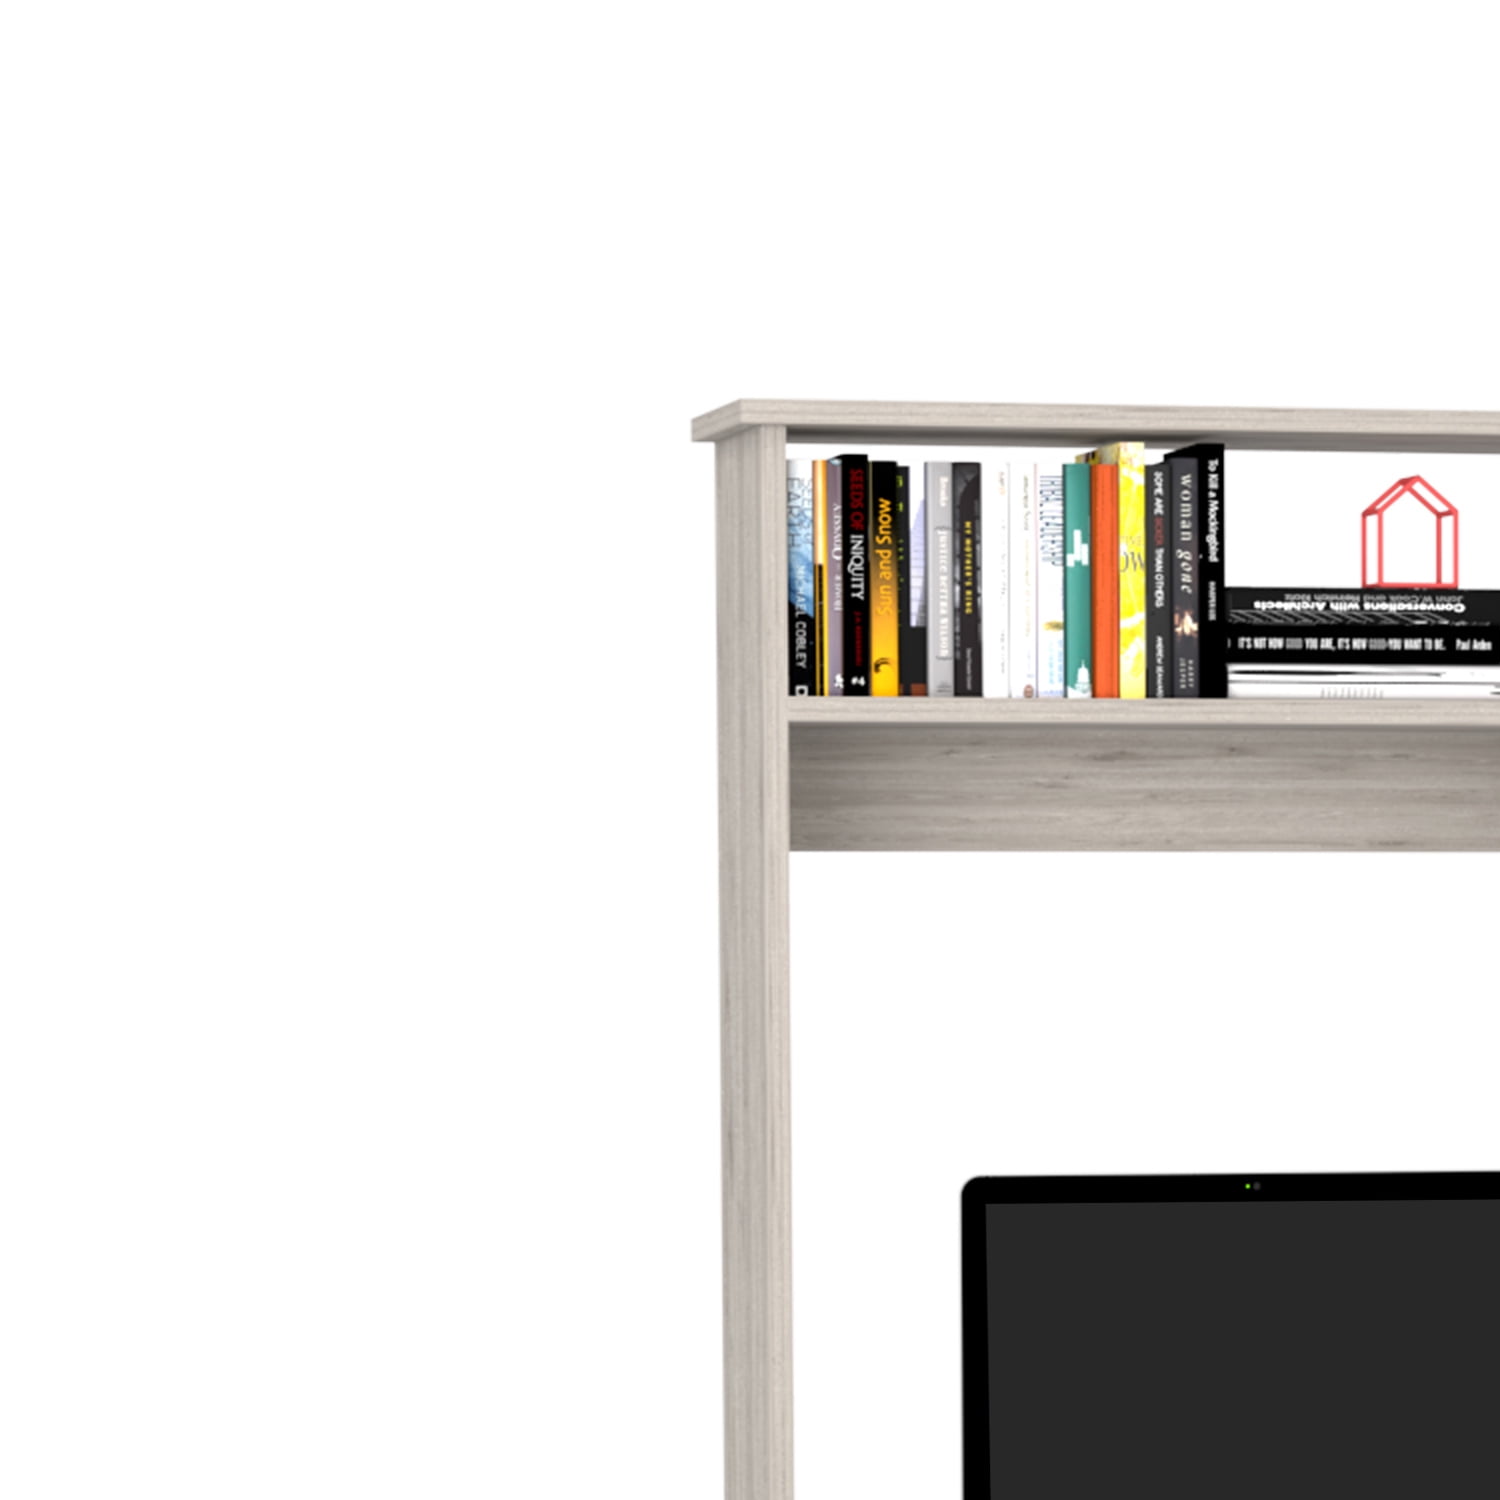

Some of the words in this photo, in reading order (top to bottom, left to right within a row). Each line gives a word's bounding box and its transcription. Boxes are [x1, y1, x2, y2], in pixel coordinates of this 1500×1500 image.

[1207, 458, 1219, 472] To
[849, 467, 865, 509] SEEDS
[1152, 471, 1165, 495] SOME
[1208, 473, 1219, 490] Kill
[850, 510, 865, 531] OF
[876, 497, 893, 545] Snow
[1153, 496, 1165, 515] ARE
[1180, 473, 1194, 542] woman
[1205, 499, 1219, 563] Mockingbird
[847, 533, 865, 601] INIQUITY
[876, 549, 892, 581] and
[964, 537, 973, 587] MOTHER'S
[1154, 547, 1165, 571] THAN
[1175, 549, 1195, 595] gone
[795, 563, 808, 617] MICHAEL
[877, 584, 893, 617] Sun
[964, 589, 973, 615] RING
[1153, 573, 1165, 608] OTHERS
[1253, 600, 1327, 612] Architects
[1329, 600, 1361, 613] with
[1363, 600, 1467, 614] Conversations
[794, 620, 808, 669] COBLEY
[1253, 637, 1267, 650] NOT
[1268, 637, 1284, 650] HOW
[1304, 637, 1318, 650] YOU
[1403, 637, 1422, 650] WANT
[1423, 637, 1434, 650] TO
